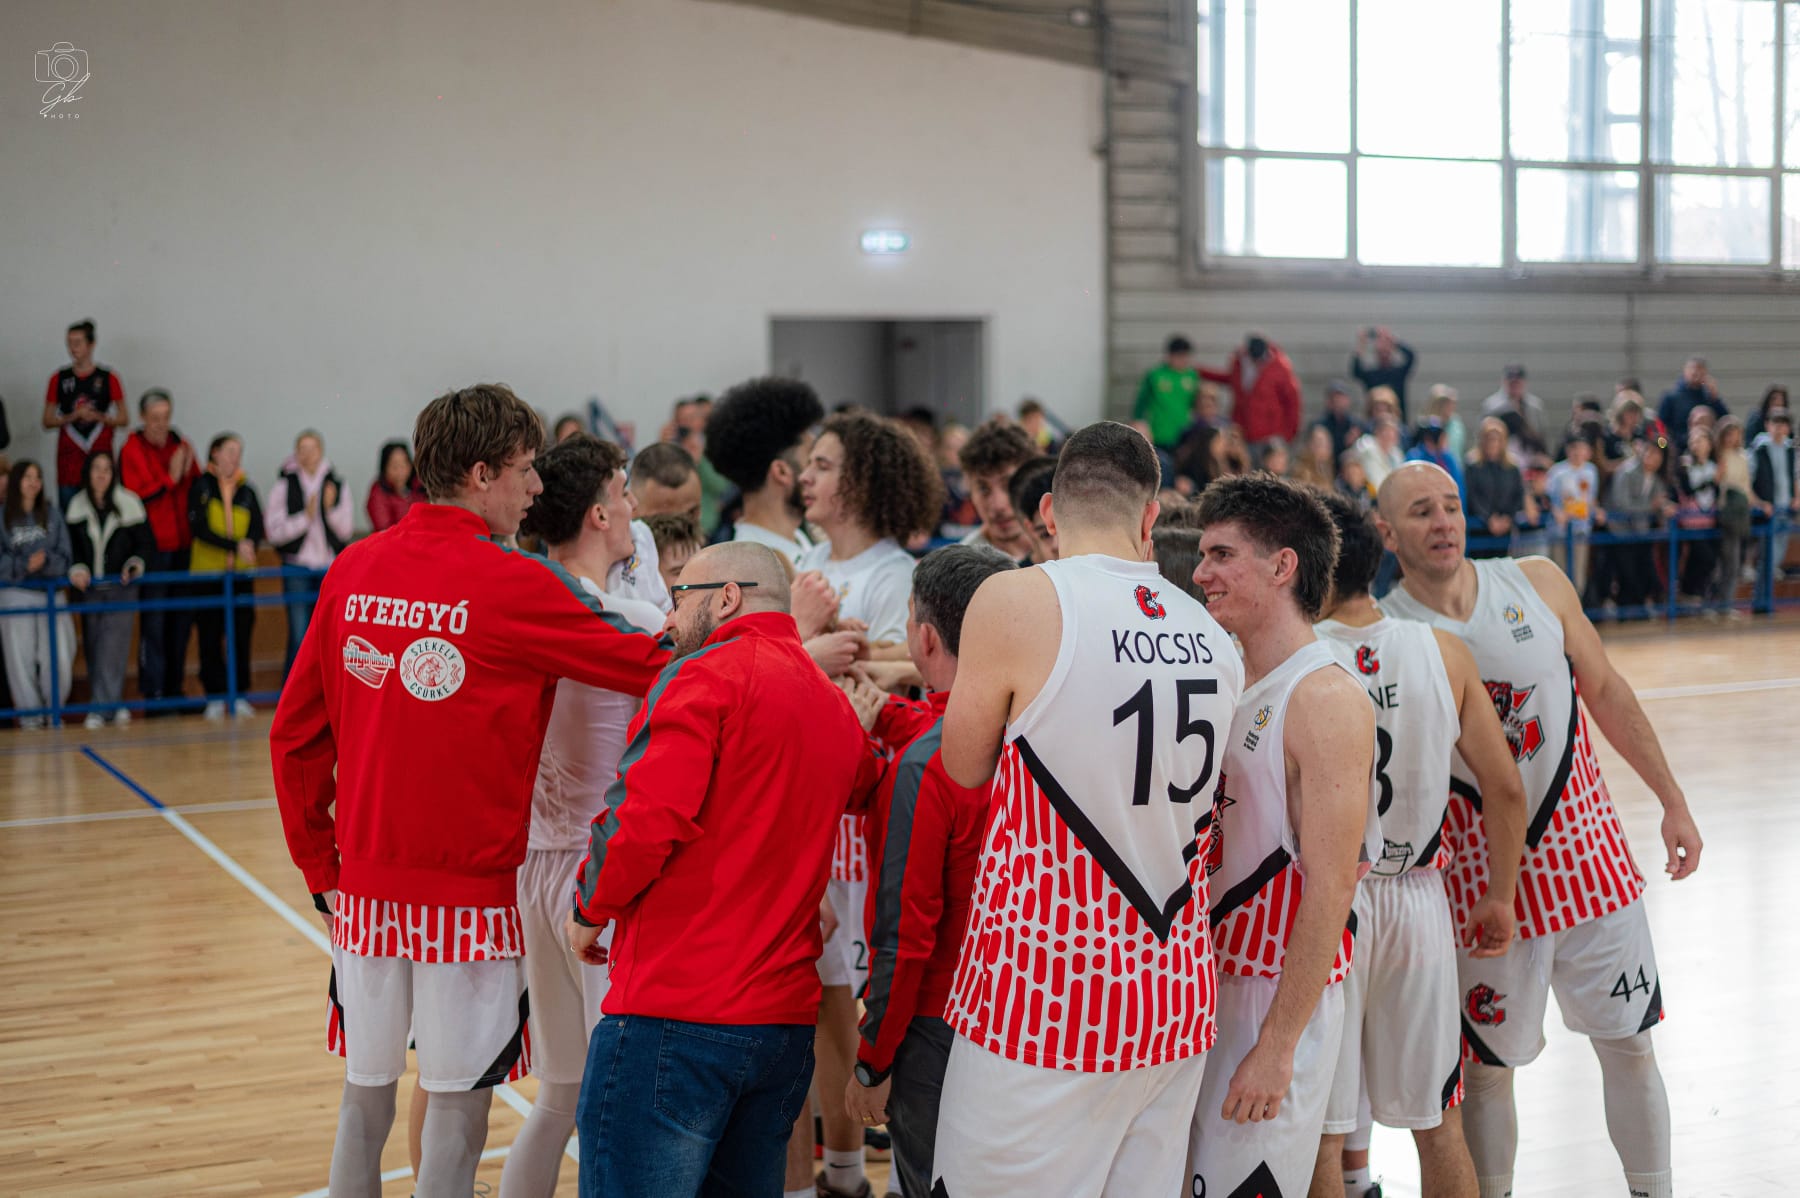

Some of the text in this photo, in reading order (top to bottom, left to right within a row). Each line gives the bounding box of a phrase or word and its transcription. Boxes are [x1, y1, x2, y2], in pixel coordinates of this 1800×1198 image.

[344, 593, 470, 635] GYERGYÓ
[410, 639, 457, 661] SZÉKELY
[1111, 629, 1213, 665] KOCSIS
[1112, 678, 1218, 806] 15
[1609, 963, 1650, 1003] 44
